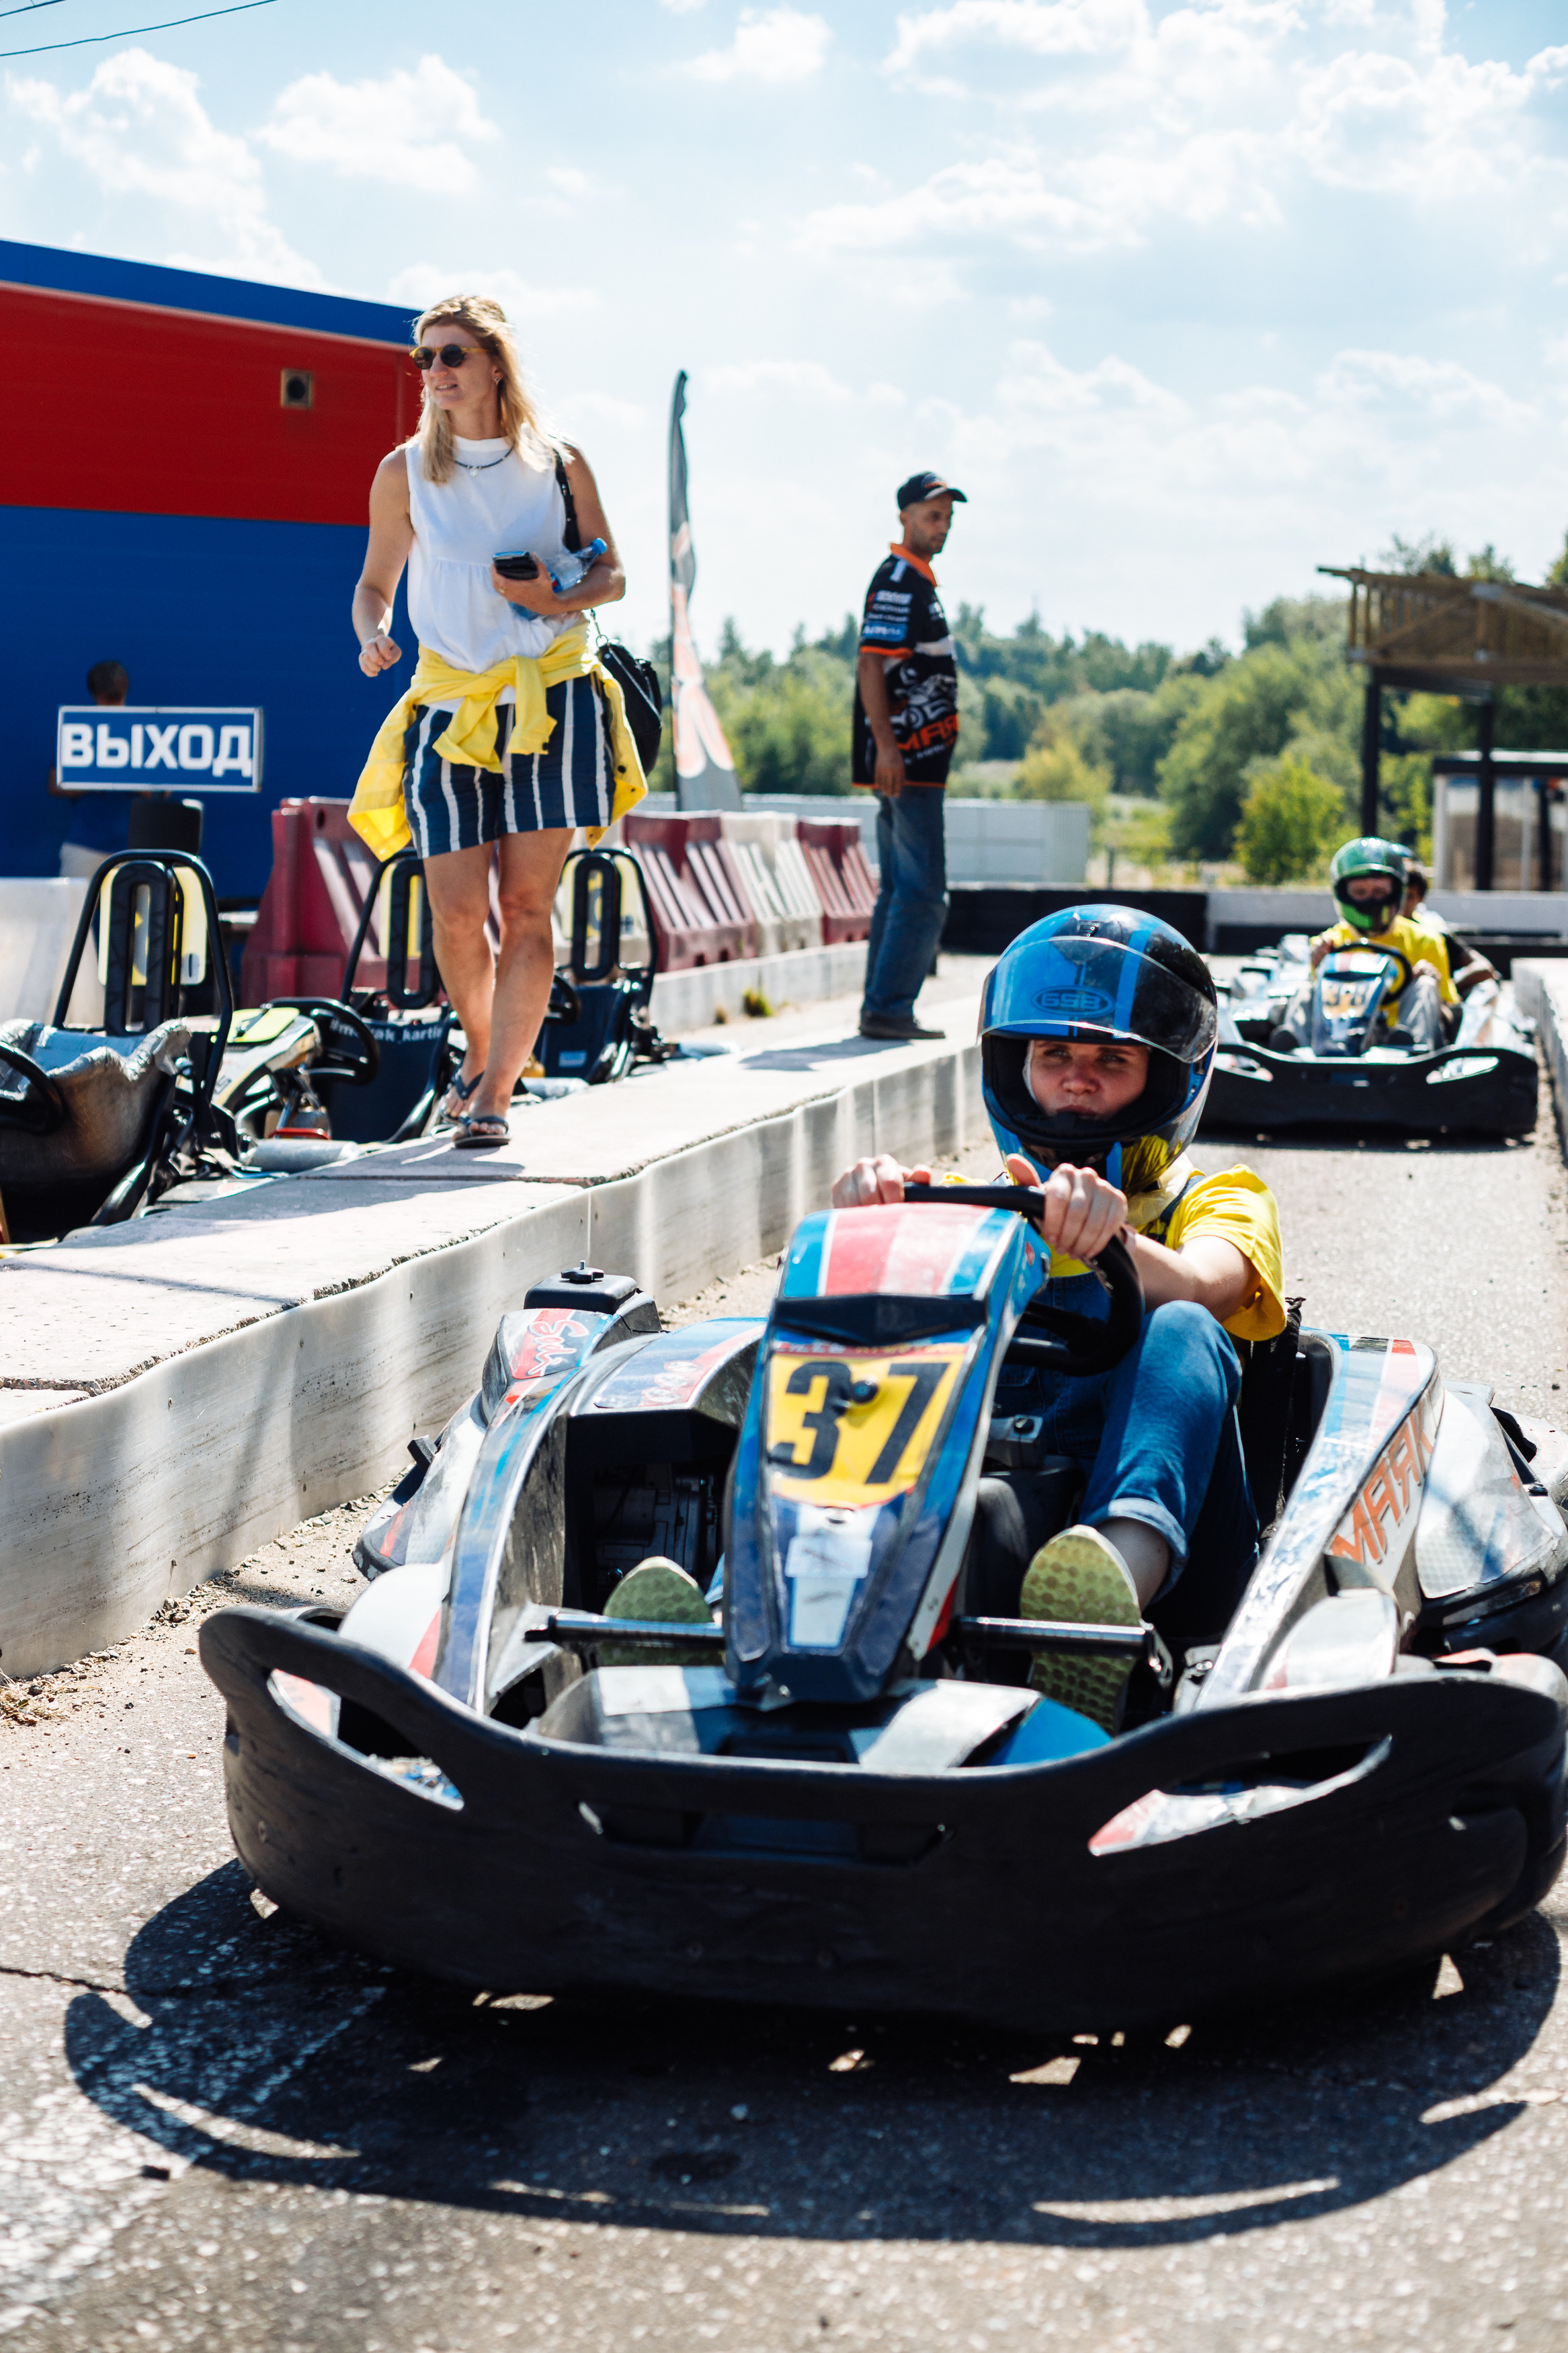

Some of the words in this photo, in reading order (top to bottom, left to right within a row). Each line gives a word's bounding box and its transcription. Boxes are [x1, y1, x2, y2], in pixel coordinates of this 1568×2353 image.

[61, 723, 253, 778] ВЫХОД
[1040, 992, 1102, 1009] GSB
[768, 1361, 950, 1485] 37
